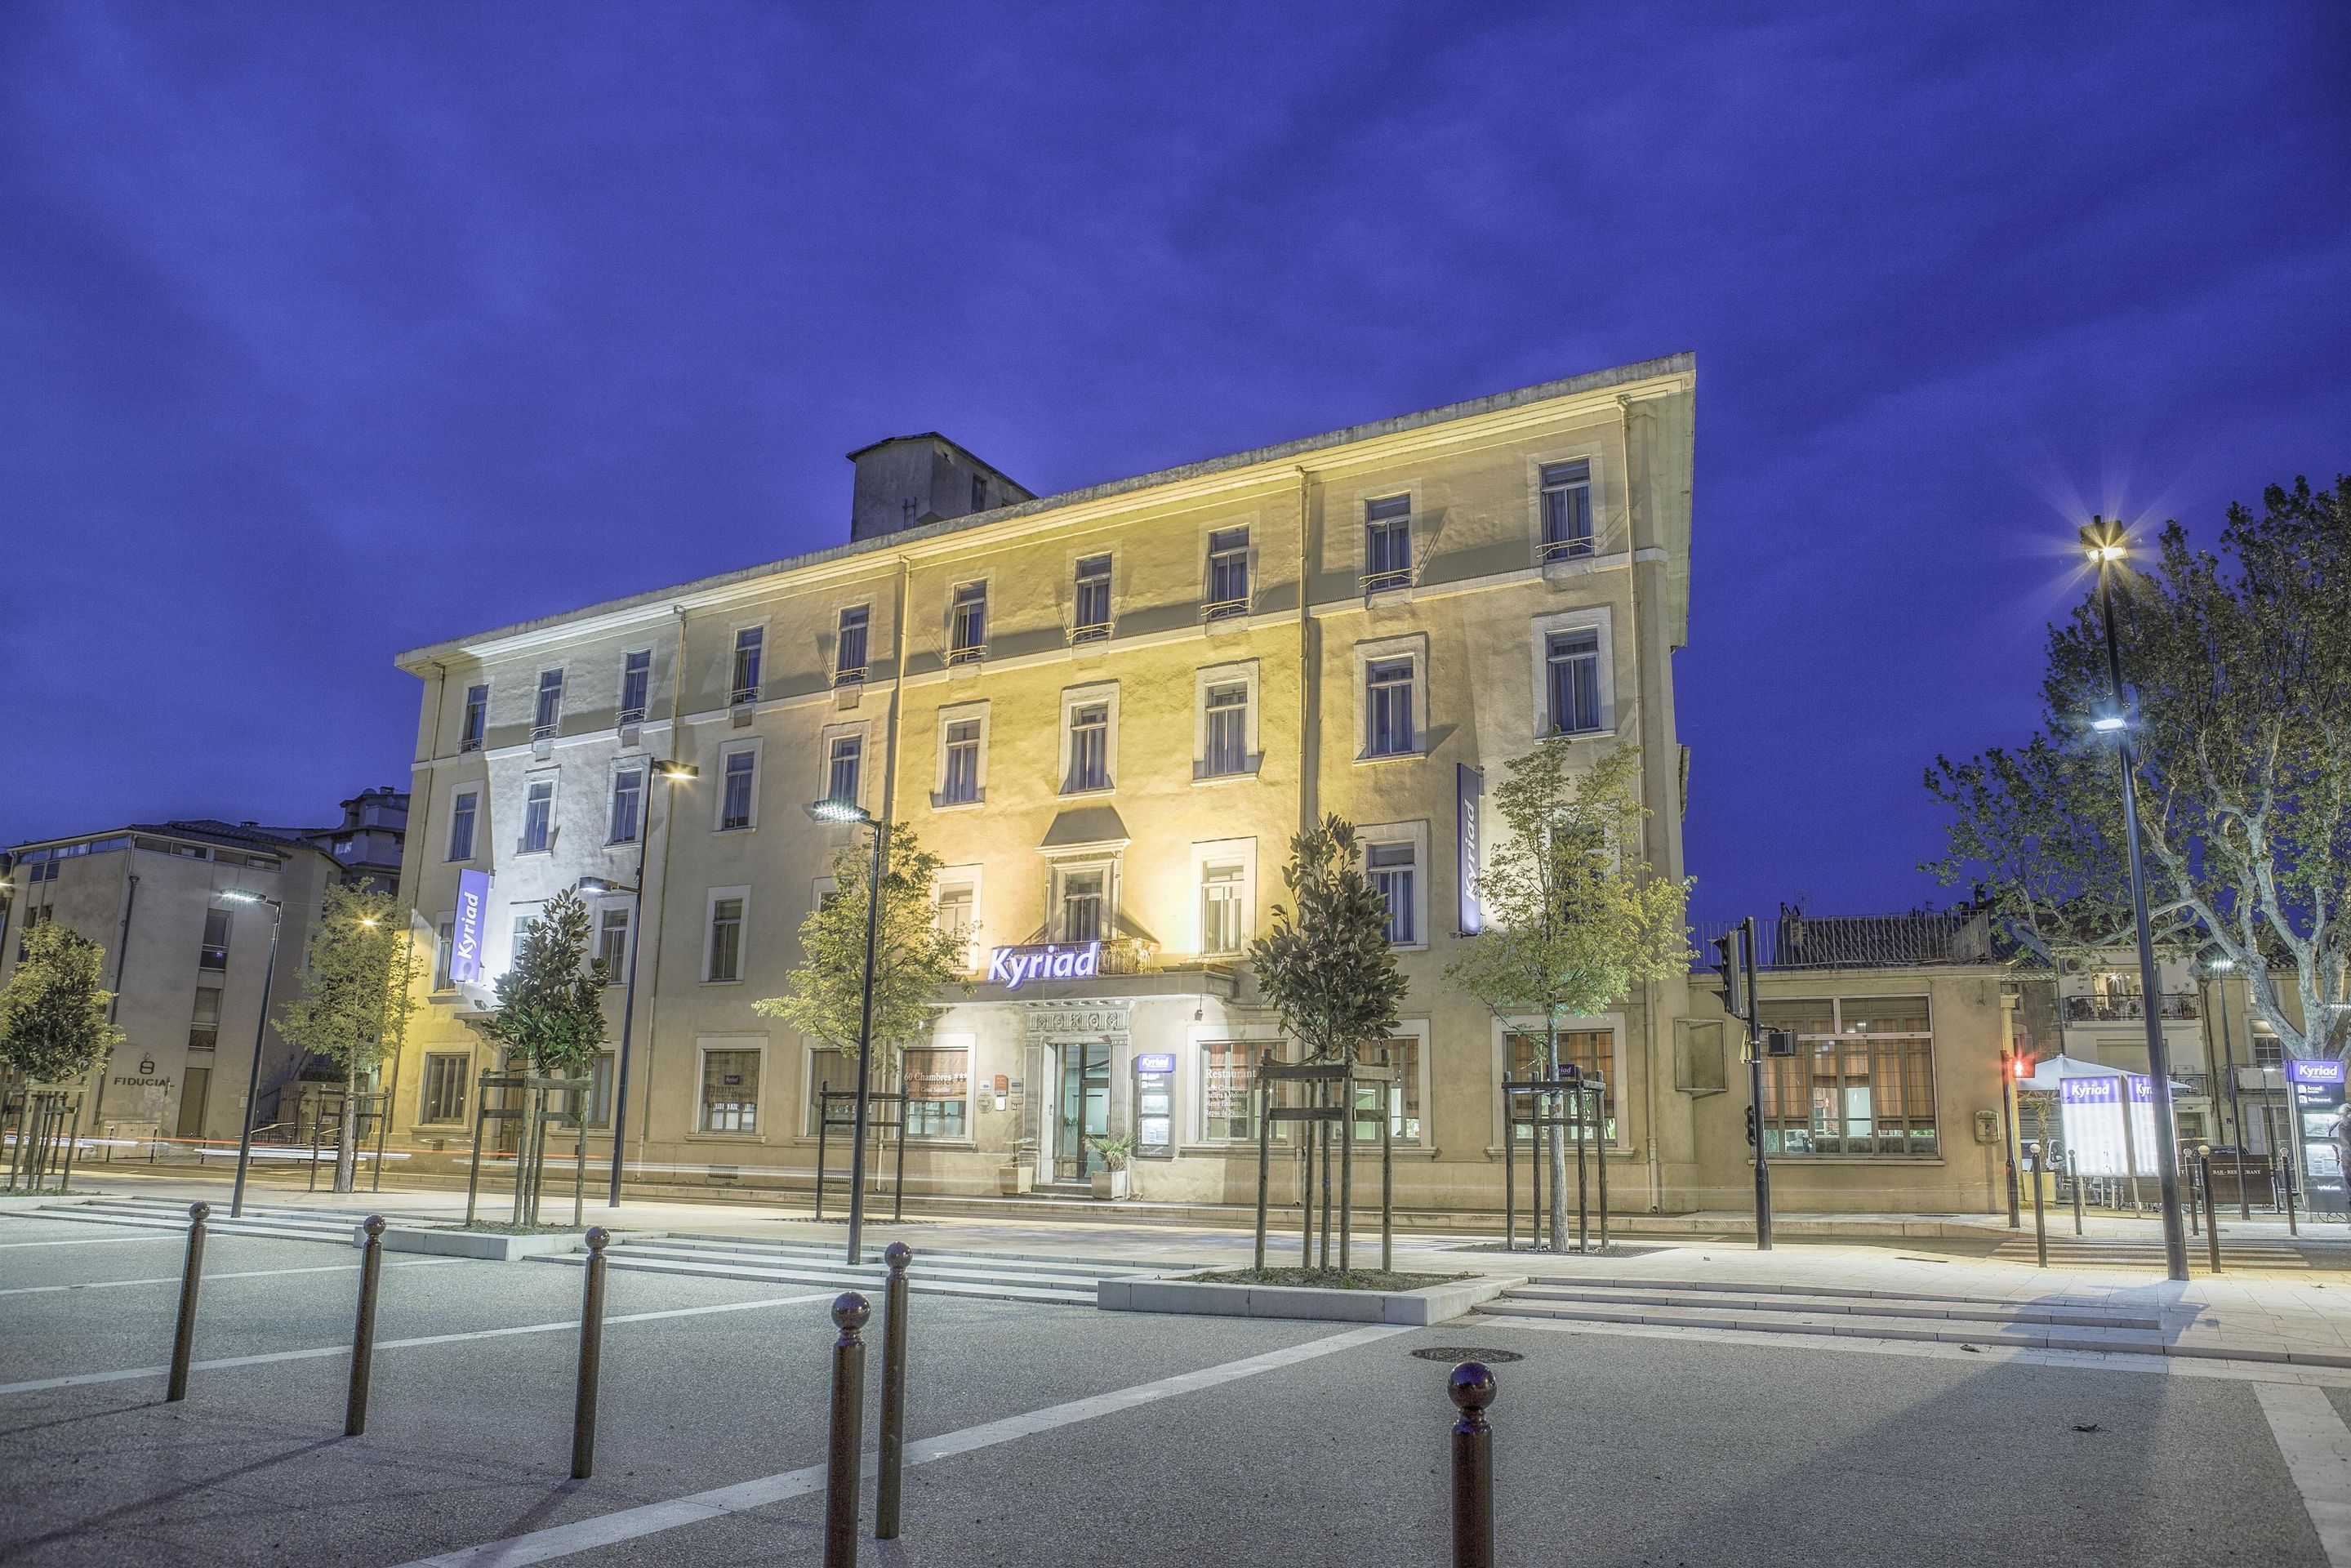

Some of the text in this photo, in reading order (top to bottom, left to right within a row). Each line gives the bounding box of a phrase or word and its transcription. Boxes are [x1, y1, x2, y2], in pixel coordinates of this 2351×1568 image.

[1464, 798, 1477, 902] Kyriad
[456, 891, 479, 960] Kyriad
[987, 942, 1101, 990] Kyriad
[1142, 1057, 1169, 1068] Kyriad
[904, 1071, 952, 1082] 60 Chambres
[1204, 1068, 1257, 1079] Restaurant
[2299, 1064, 2338, 1078] Kyriad
[2071, 1083, 2110, 1098] Kyriad
[2135, 1083, 2153, 1098] Kyr
